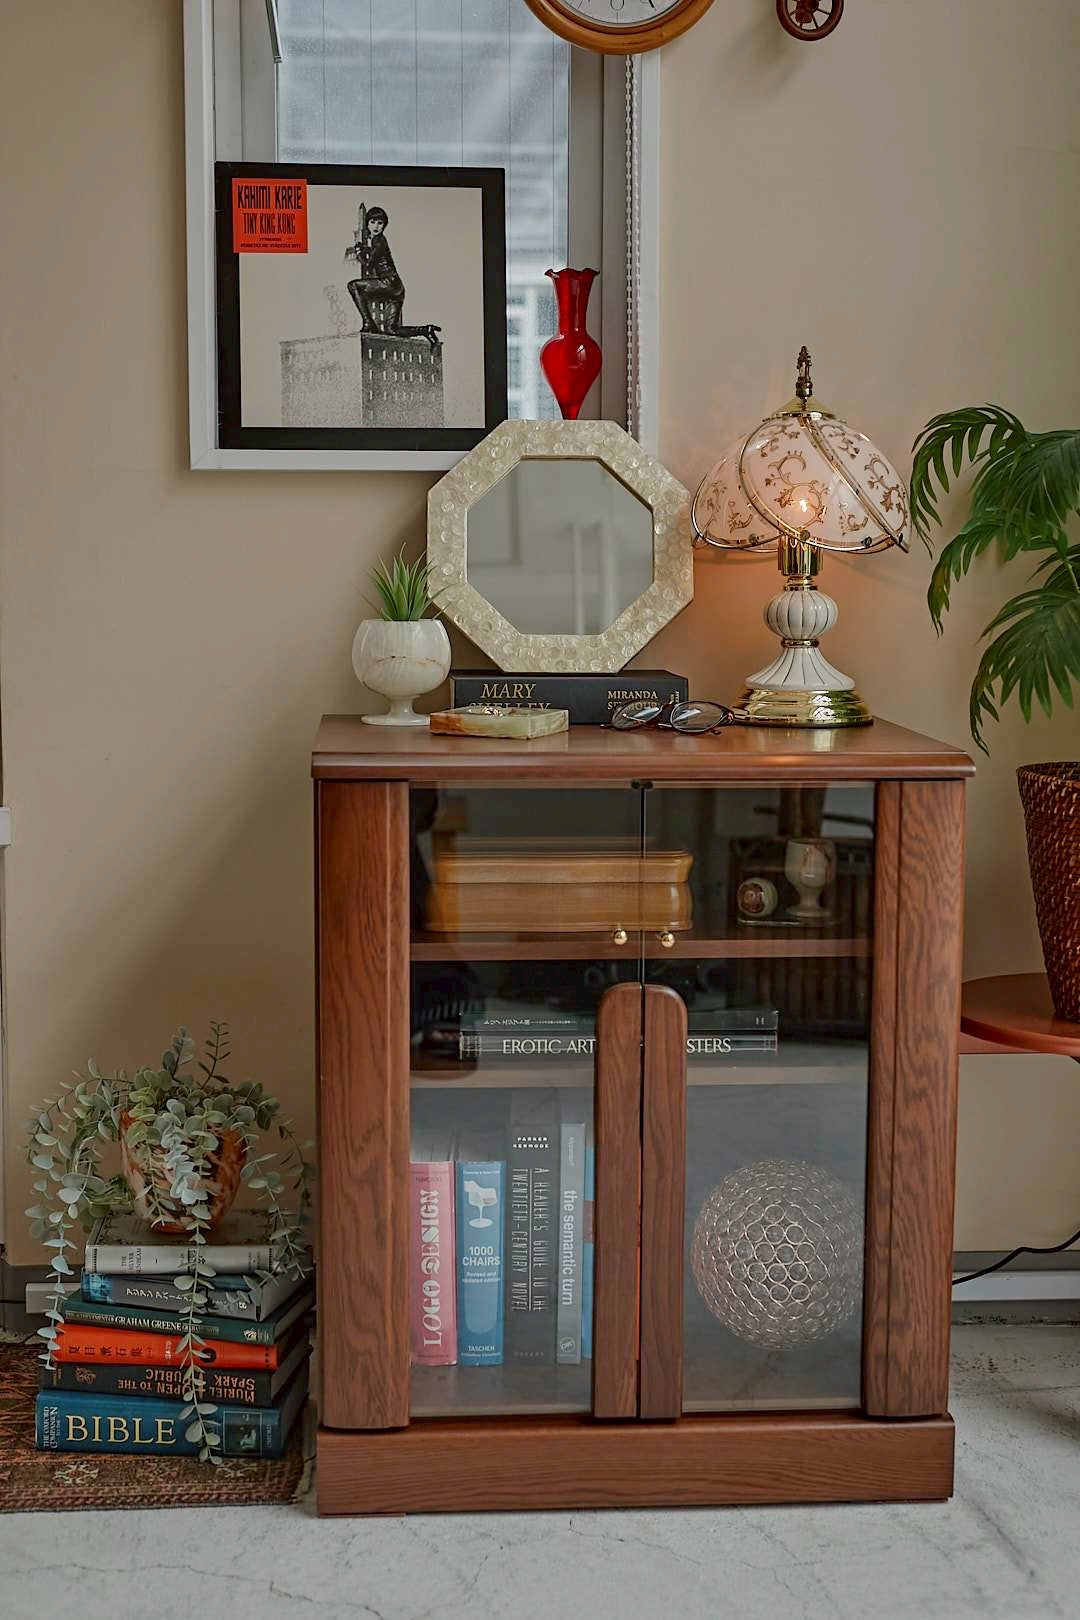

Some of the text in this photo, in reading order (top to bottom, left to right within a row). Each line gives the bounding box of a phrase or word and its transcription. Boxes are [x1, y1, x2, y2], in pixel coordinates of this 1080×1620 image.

[237, 185, 302, 209] KAHIMI KARIE
[243, 212, 296, 234] TINY KING KONG
[480, 683, 536, 699] MARY
[607, 690, 658, 700] MIRANDA
[502, 1038, 731, 1054] EROTIC ART STERS
[420, 1188, 441, 1276] DESIGN
[469, 1246, 494, 1256] 1000
[562, 1190, 577, 1306] the semantic turn
[462, 1256, 500, 1266] CHAIRS
[511, 1281, 528, 1312] NOVEL
[423, 1279, 442, 1348] LOGO
[115, 1316, 150, 1328] GRAHAM
[151, 1319, 182, 1331] GREENE
[117, 1378, 191, 1395] OPEN TO THE
[214, 1374, 256, 1391] SPARK
[209, 1386, 255, 1403] MURIEL
[65, 1415, 177, 1445] BIBLE
